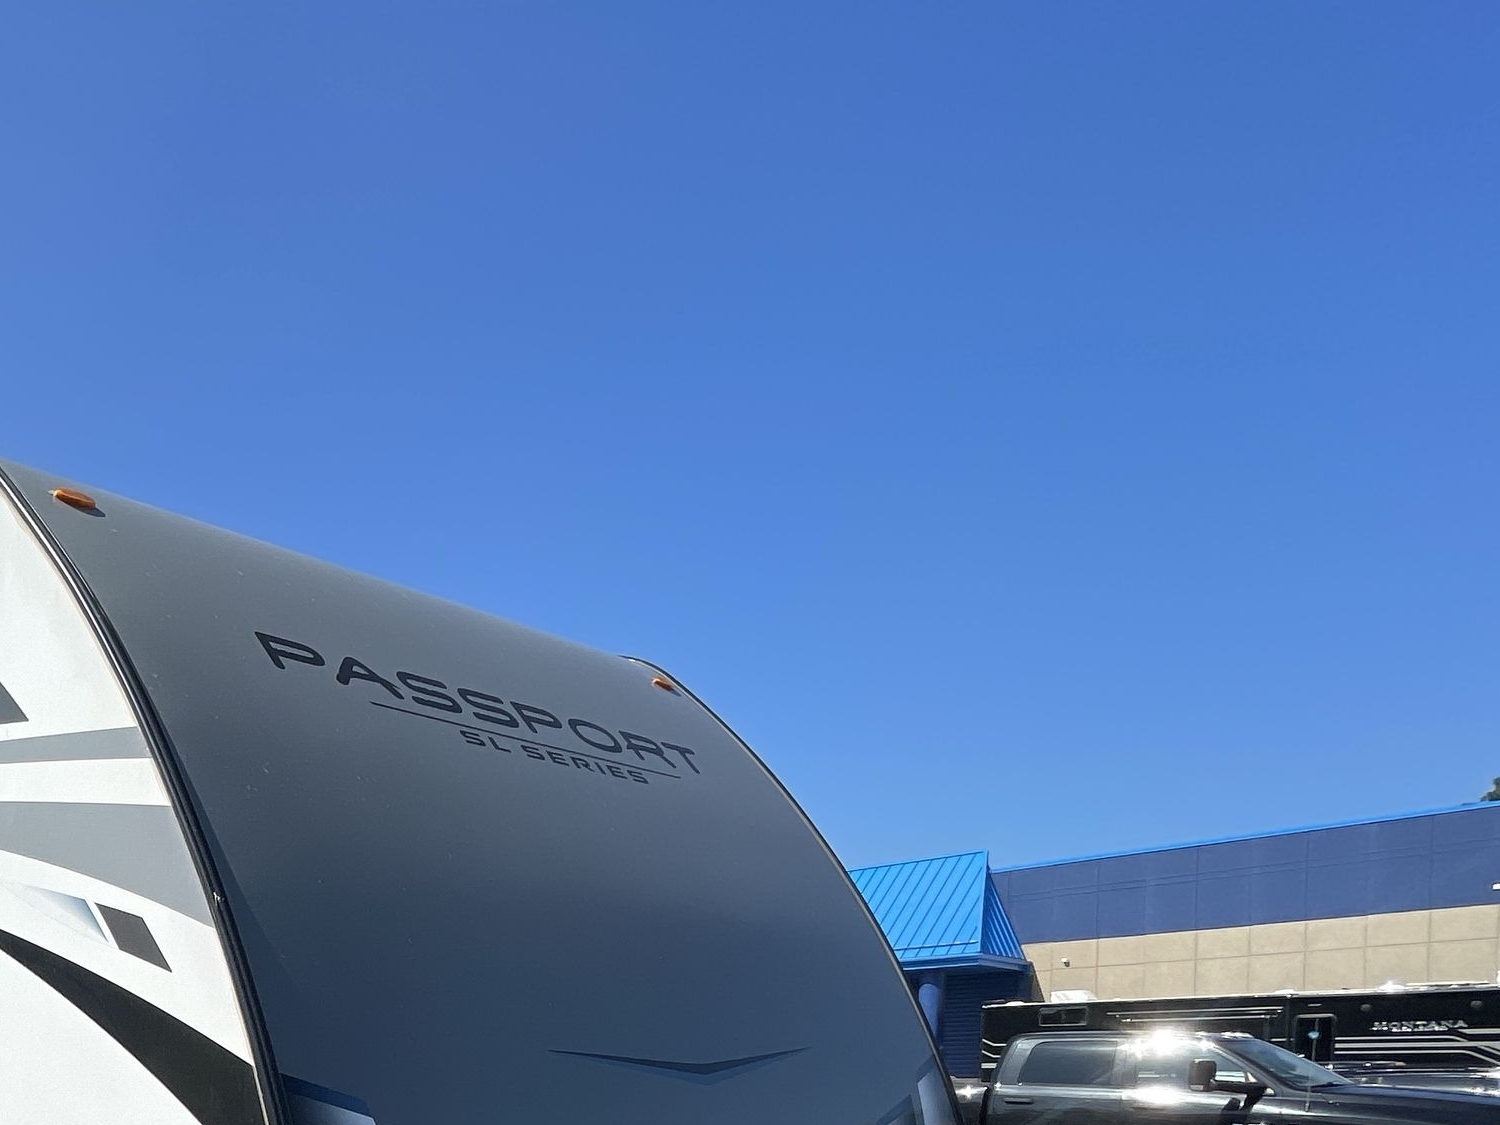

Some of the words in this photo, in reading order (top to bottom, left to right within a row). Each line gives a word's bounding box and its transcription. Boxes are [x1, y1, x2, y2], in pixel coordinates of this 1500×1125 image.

[254, 630, 701, 775] PASSPORT
[459, 728, 511, 754] SL
[520, 743, 649, 785] SERIES
